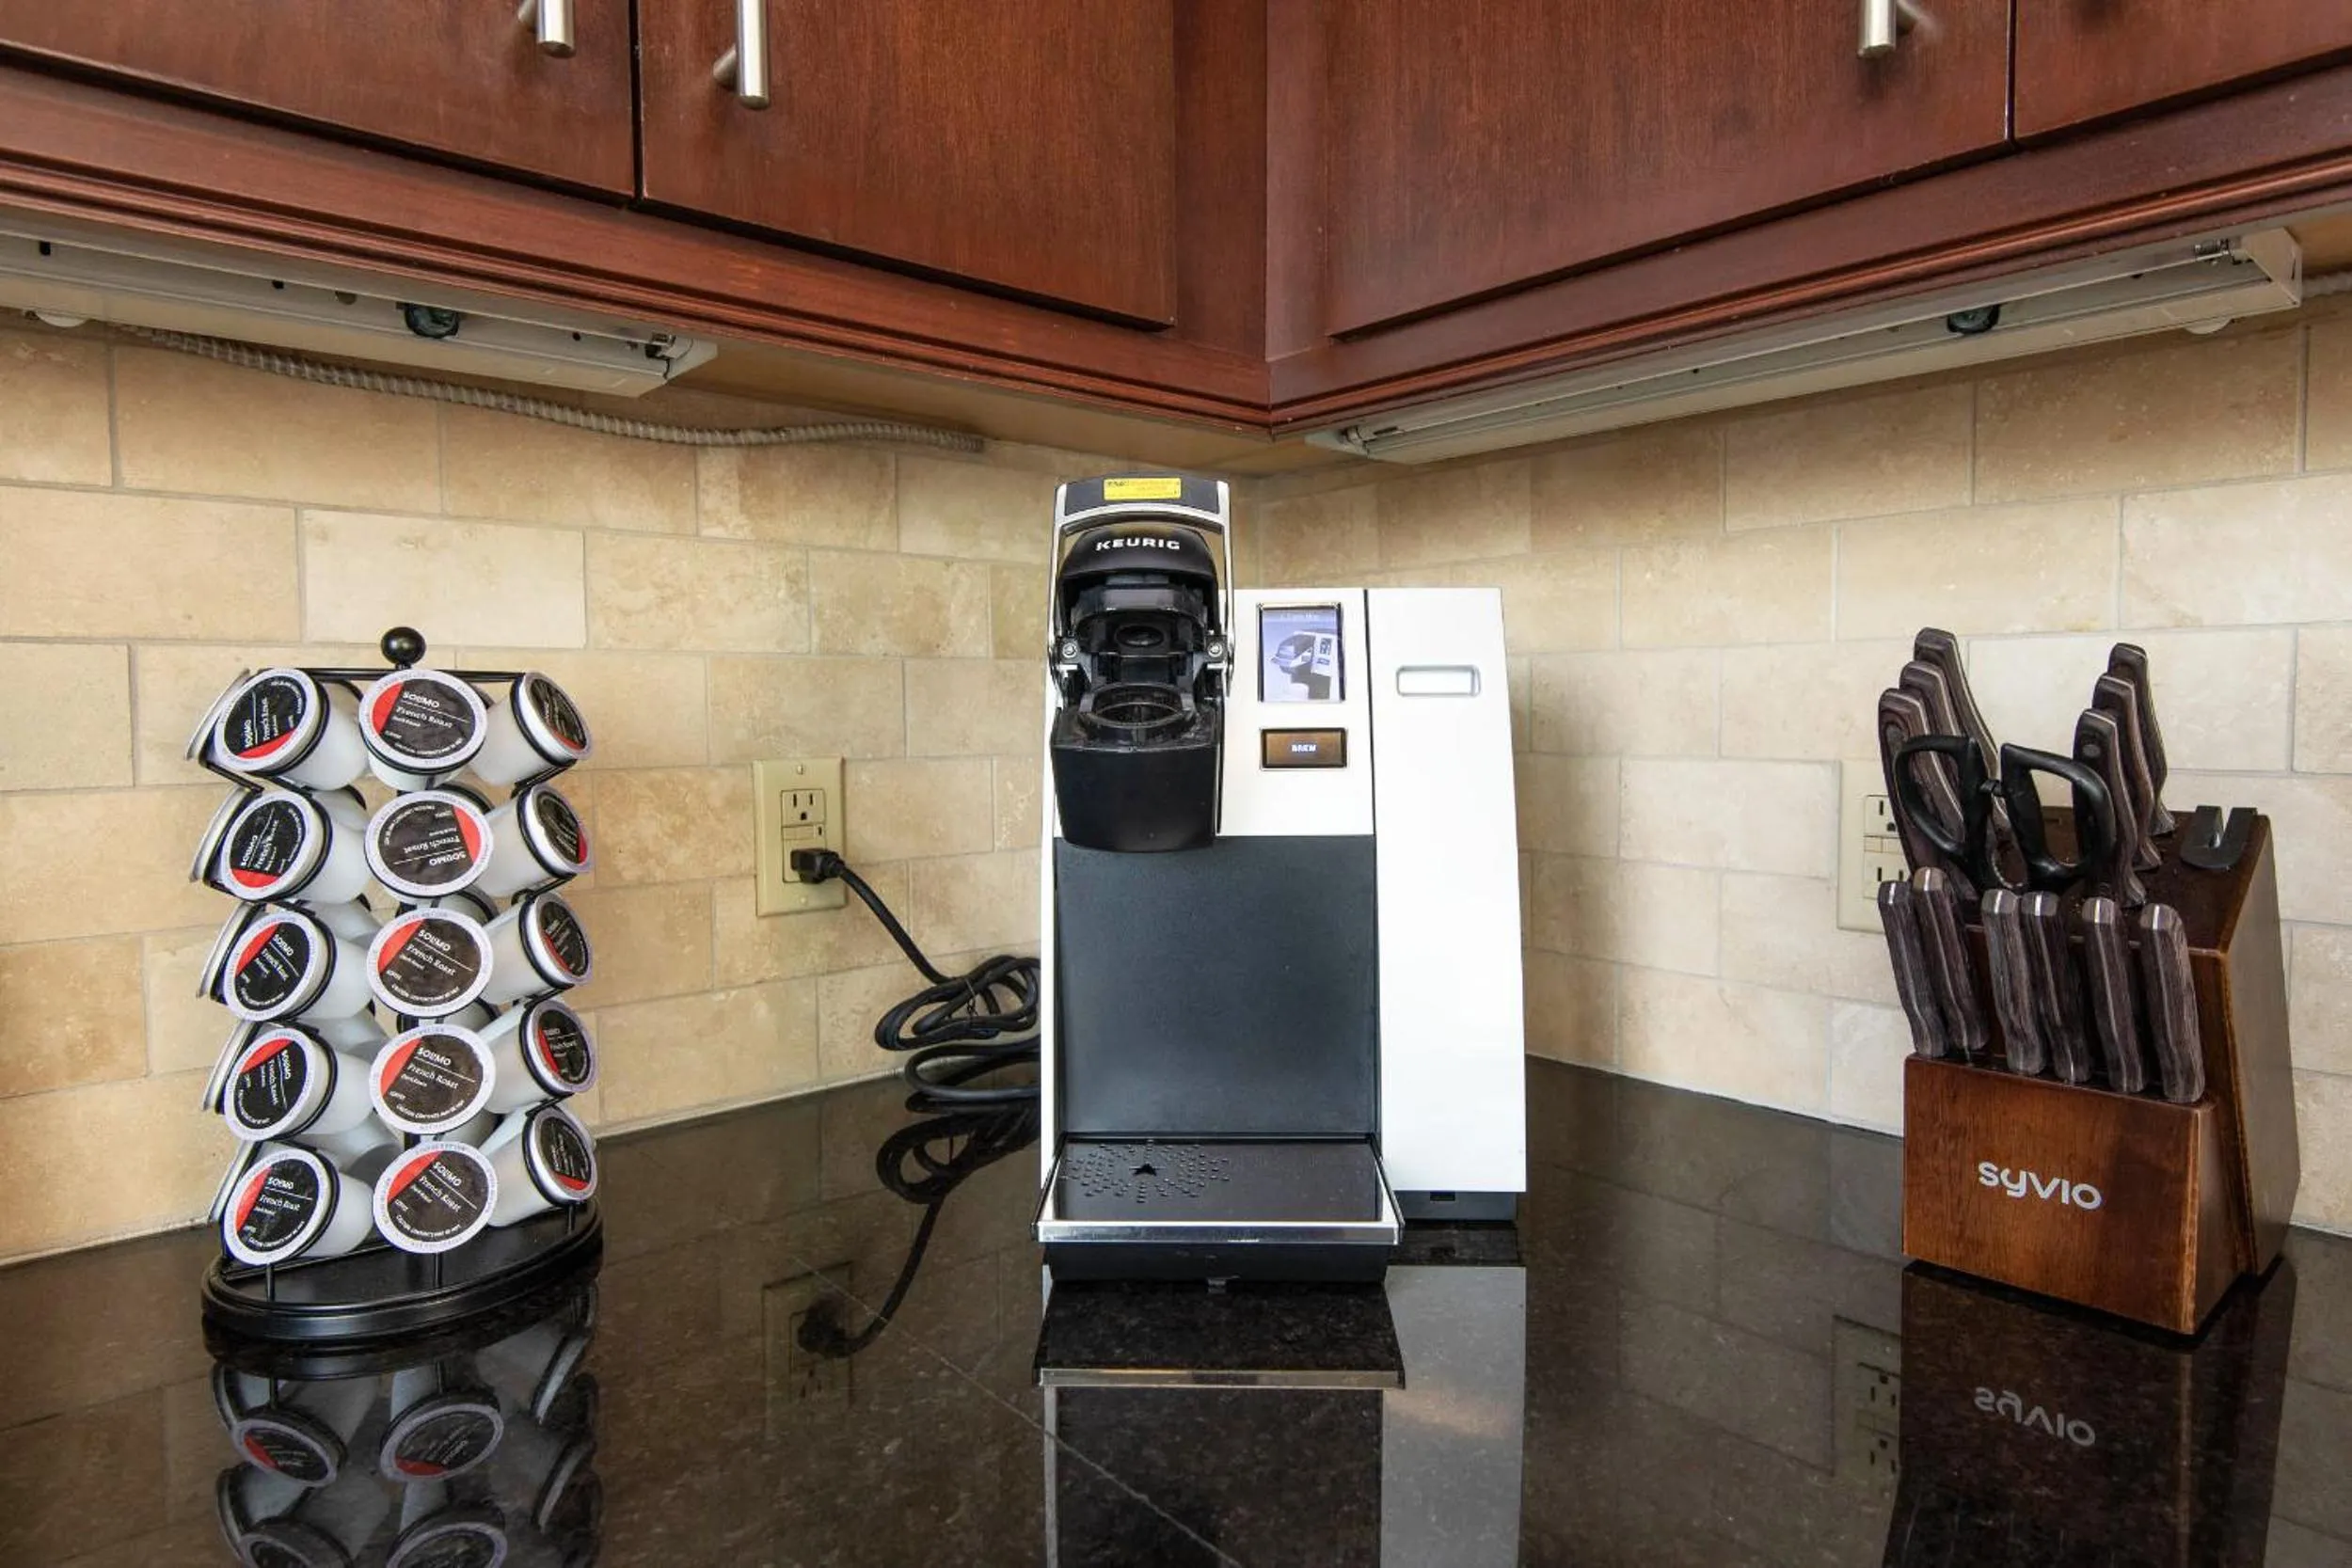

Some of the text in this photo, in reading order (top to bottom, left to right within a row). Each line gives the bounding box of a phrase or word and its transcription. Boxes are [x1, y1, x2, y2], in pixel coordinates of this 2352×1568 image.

[1095, 537, 1180, 551] KEURIG
[396, 706, 427, 721] French
[429, 835, 460, 848] French
[406, 943, 456, 975] French Roast
[406, 1063, 459, 1089] French Roast
[419, 1176, 443, 1197] French
